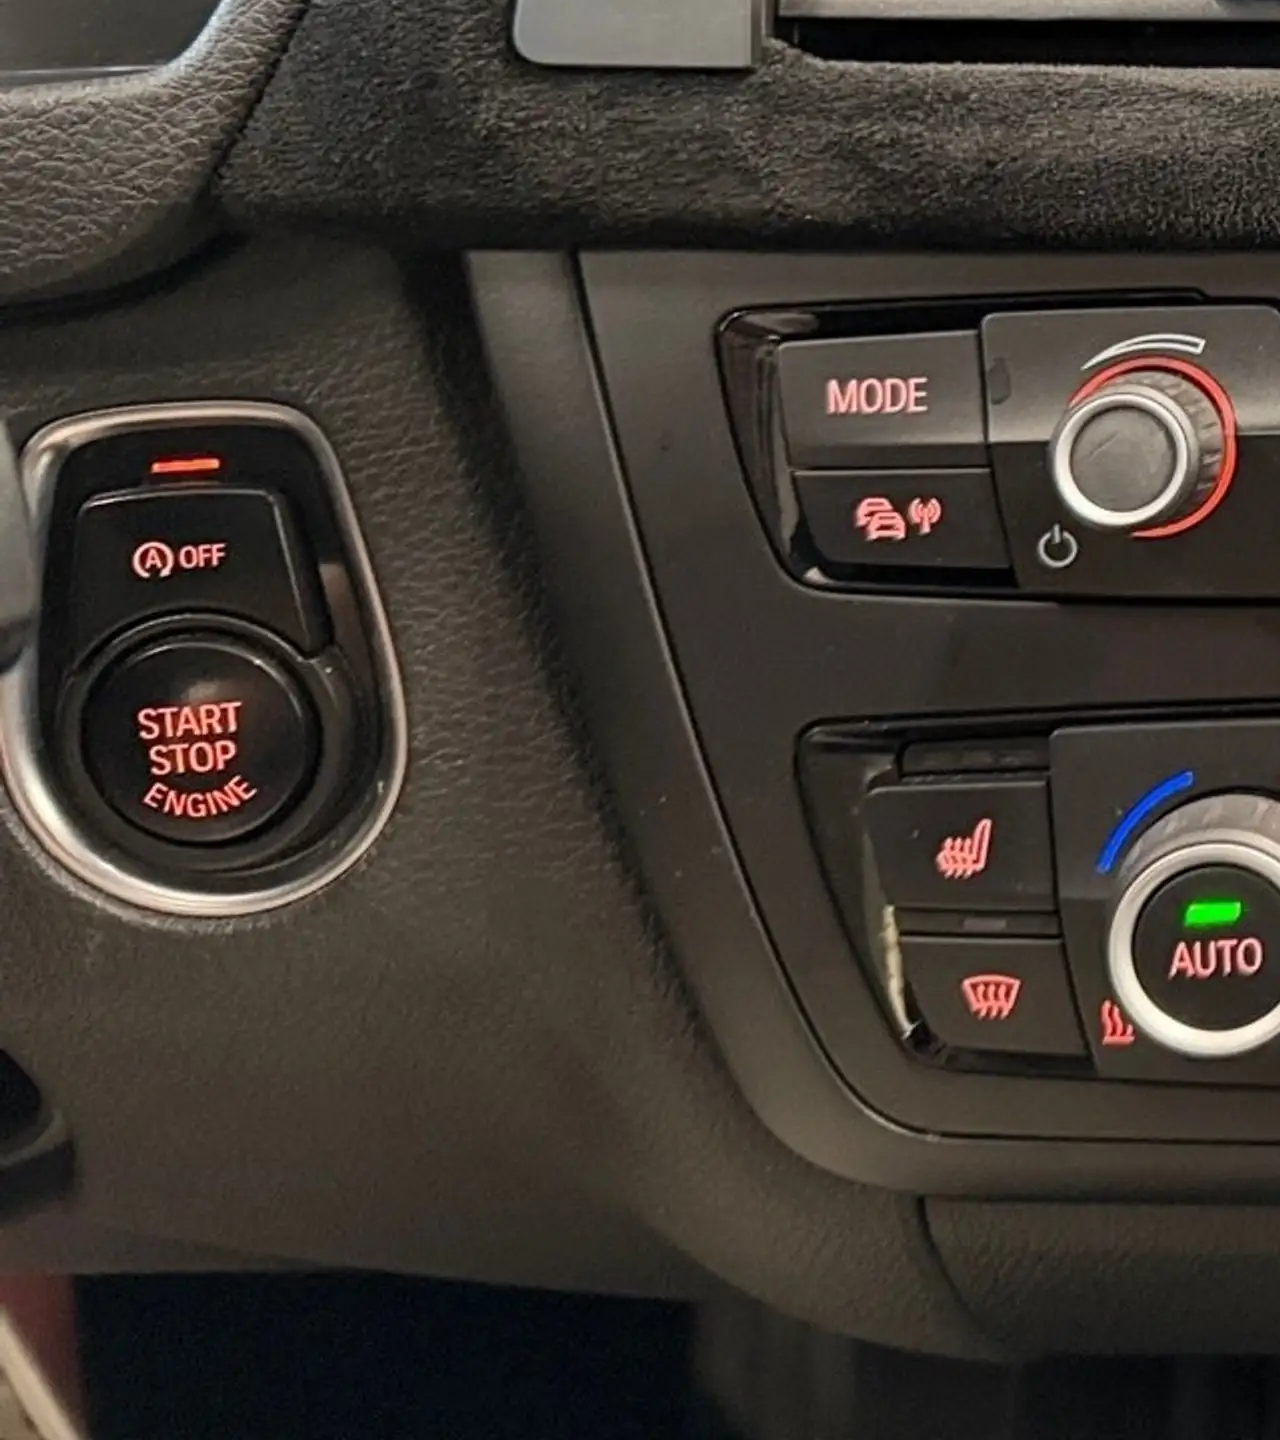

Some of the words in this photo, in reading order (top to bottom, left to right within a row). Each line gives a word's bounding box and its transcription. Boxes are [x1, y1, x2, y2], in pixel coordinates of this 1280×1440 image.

[826, 377, 928, 414] MODE
[179, 543, 226, 568] OFF
[138, 702, 242, 740] START
[149, 740, 237, 776] STOP
[143, 774, 257, 818] ENGINE
[1168, 938, 1263, 979] AUTO
